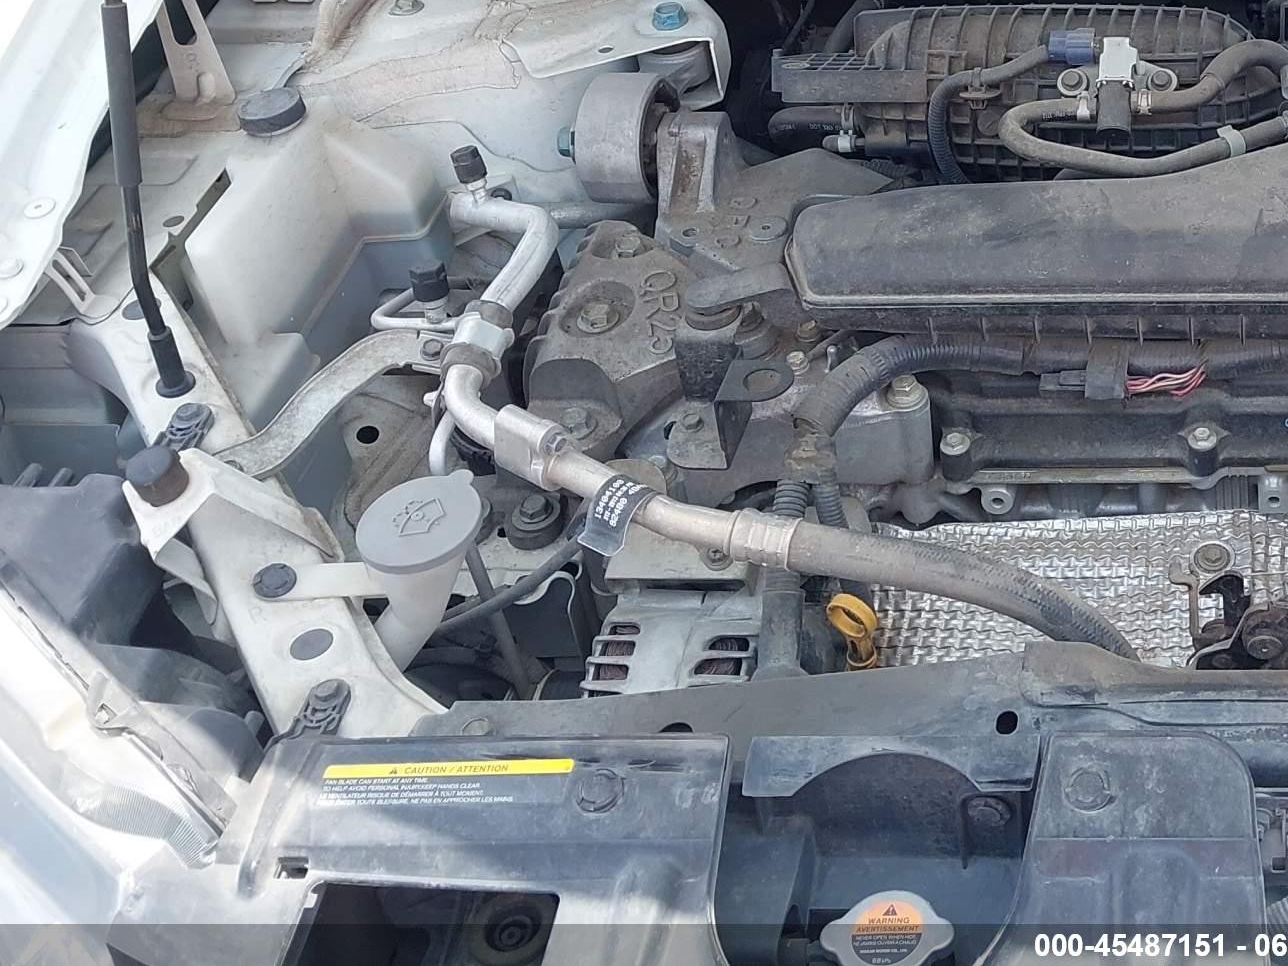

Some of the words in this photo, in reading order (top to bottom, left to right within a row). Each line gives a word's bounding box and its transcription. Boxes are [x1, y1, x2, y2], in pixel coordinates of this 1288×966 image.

[639, 269, 682, 355] QR25
[404, 766, 447, 774] CAUTION
[456, 764, 510, 773] ATTENTION
[856, 925, 920, 933] AVERTISSEMENT
